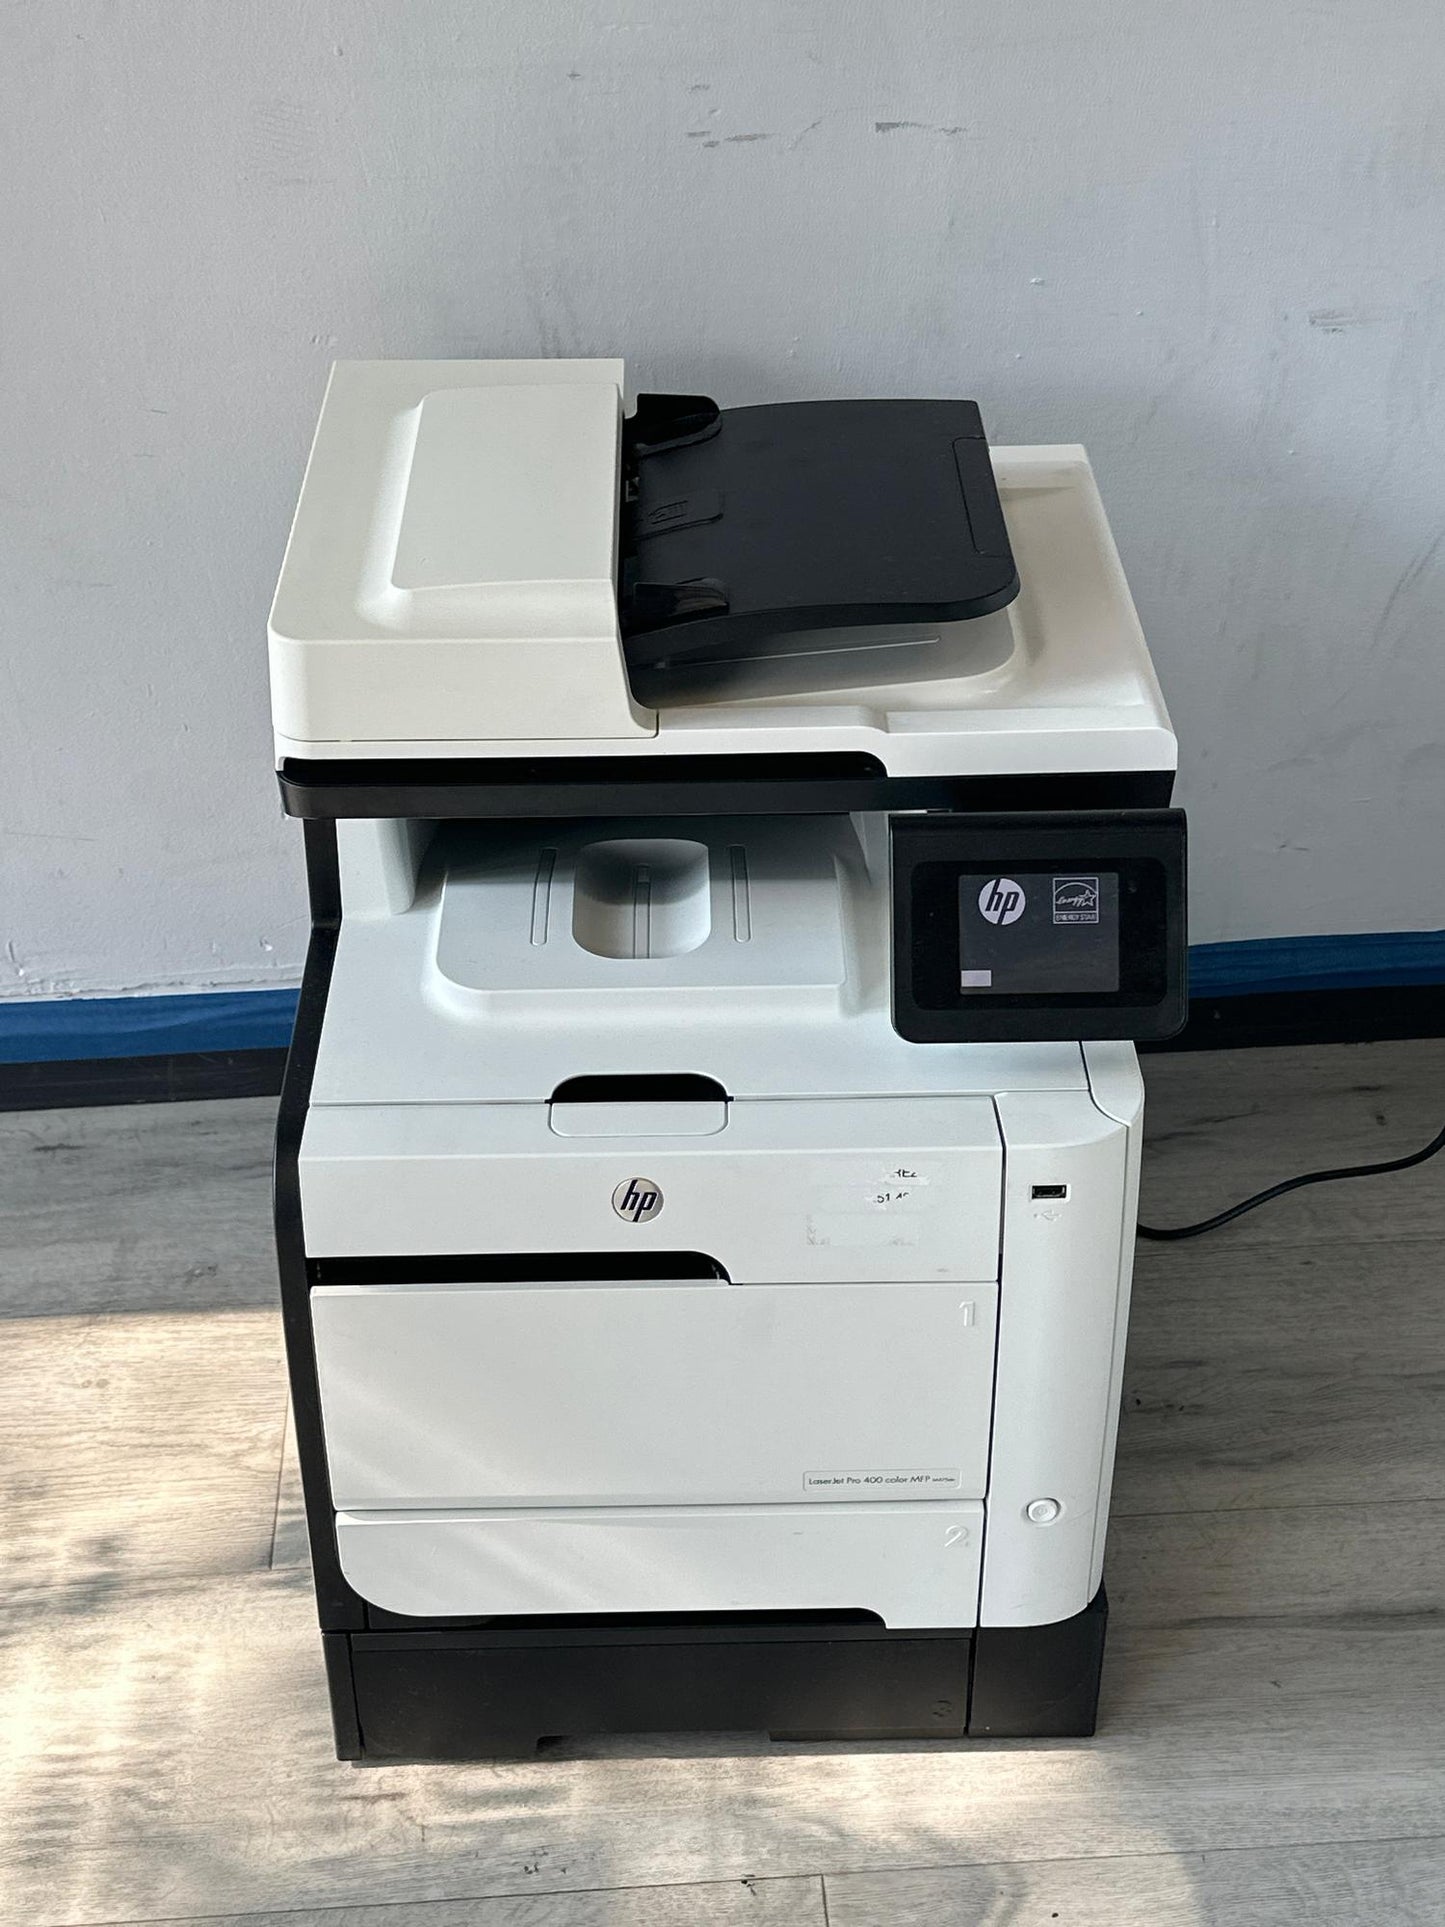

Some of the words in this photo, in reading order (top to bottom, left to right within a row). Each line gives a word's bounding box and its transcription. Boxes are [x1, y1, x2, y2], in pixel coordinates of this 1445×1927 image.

[985, 878, 1020, 925] hp
[620, 1179, 658, 1223] hp
[808, 1477, 844, 1485] LaserJet
[846, 1476, 861, 1484] Pro
[885, 1475, 908, 1483] color
